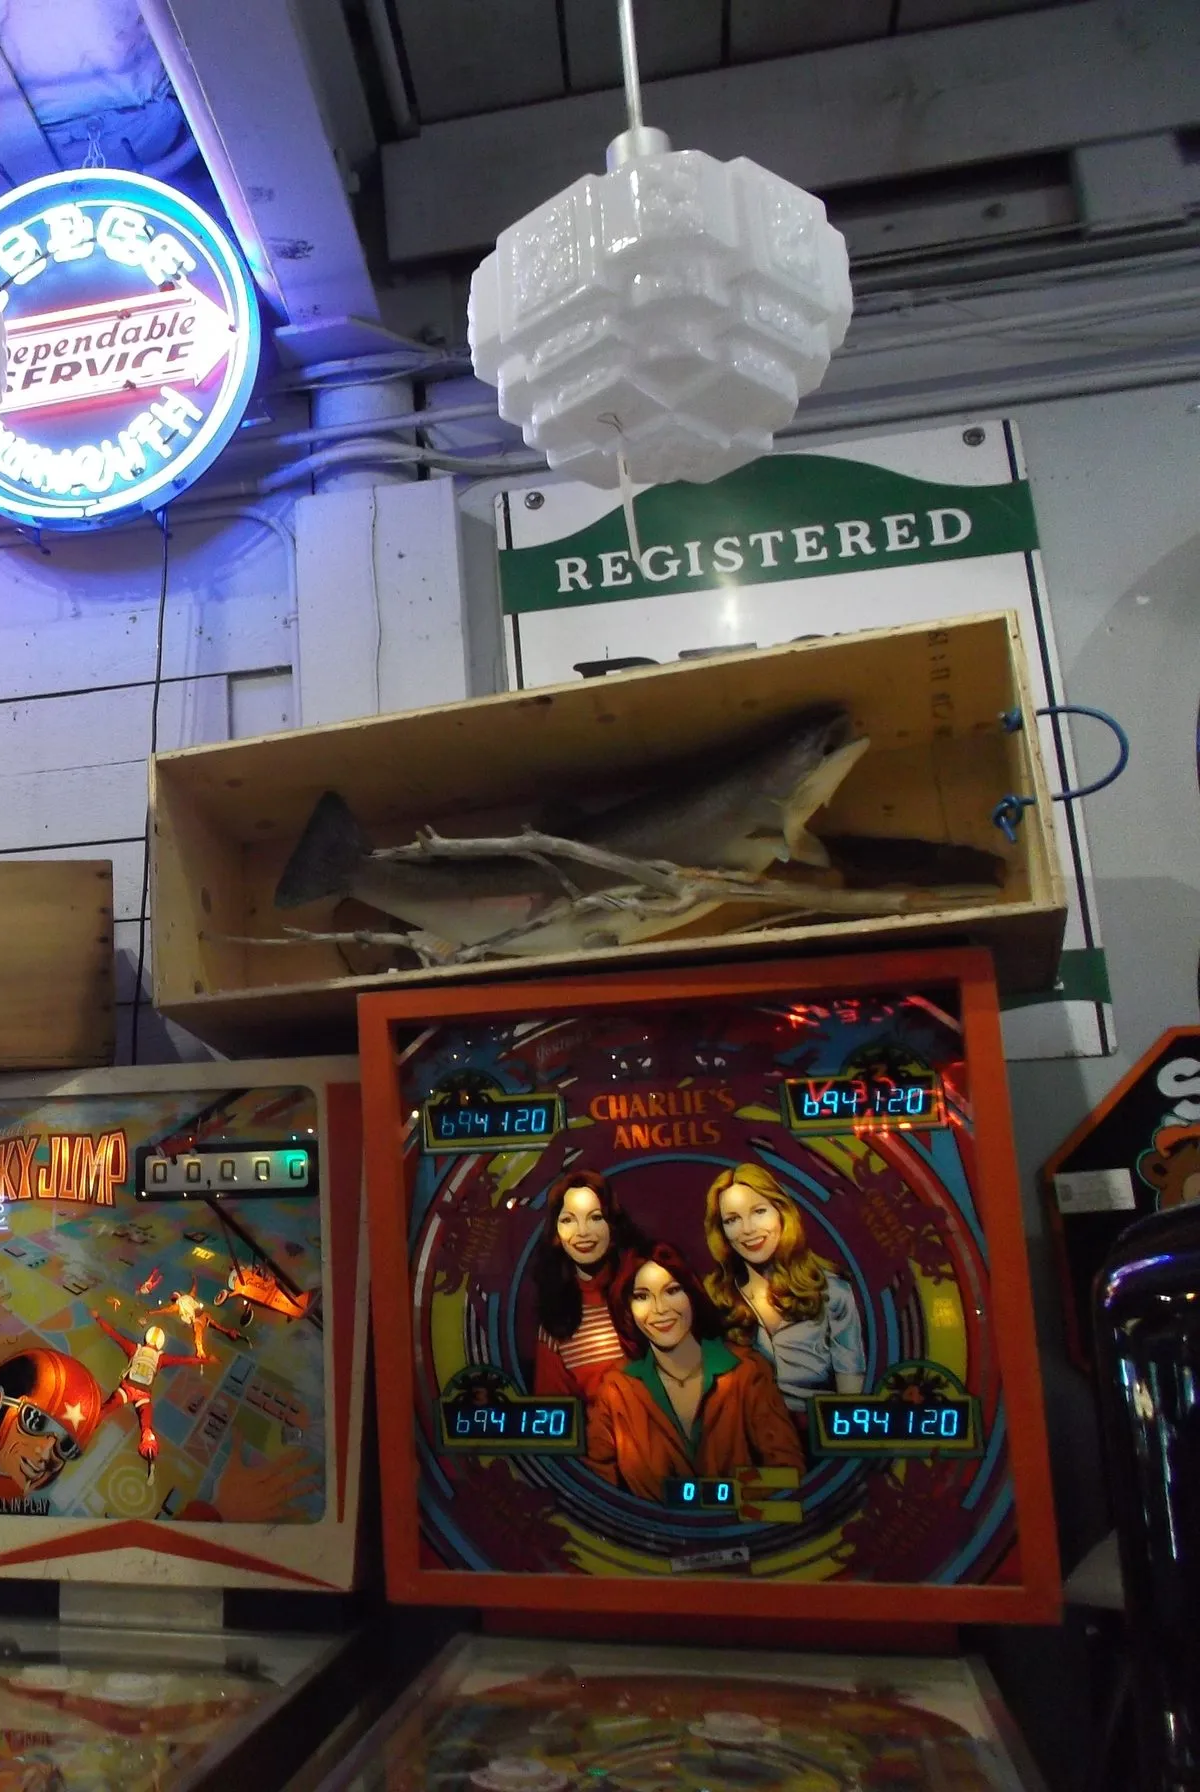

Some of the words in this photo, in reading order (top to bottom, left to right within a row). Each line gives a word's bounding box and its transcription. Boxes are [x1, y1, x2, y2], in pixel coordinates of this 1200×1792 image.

[556, 506, 974, 594] REGISTERED
[589, 1087, 736, 1121] CHARLIE'S
[613, 1119, 724, 1150] ANGELS
[38, 1130, 127, 1207] JUMP
[456, 1409, 506, 1433] 694
[521, 1409, 565, 1435] 120
[833, 1409, 890, 1435] 694
[908, 1409, 958, 1436] 120
[11, 1496, 21, 1512] IN
[23, 1496, 49, 1514] PLAY
[683, 1482, 695, 1501] 0
[717, 1483, 729, 1501] 0
